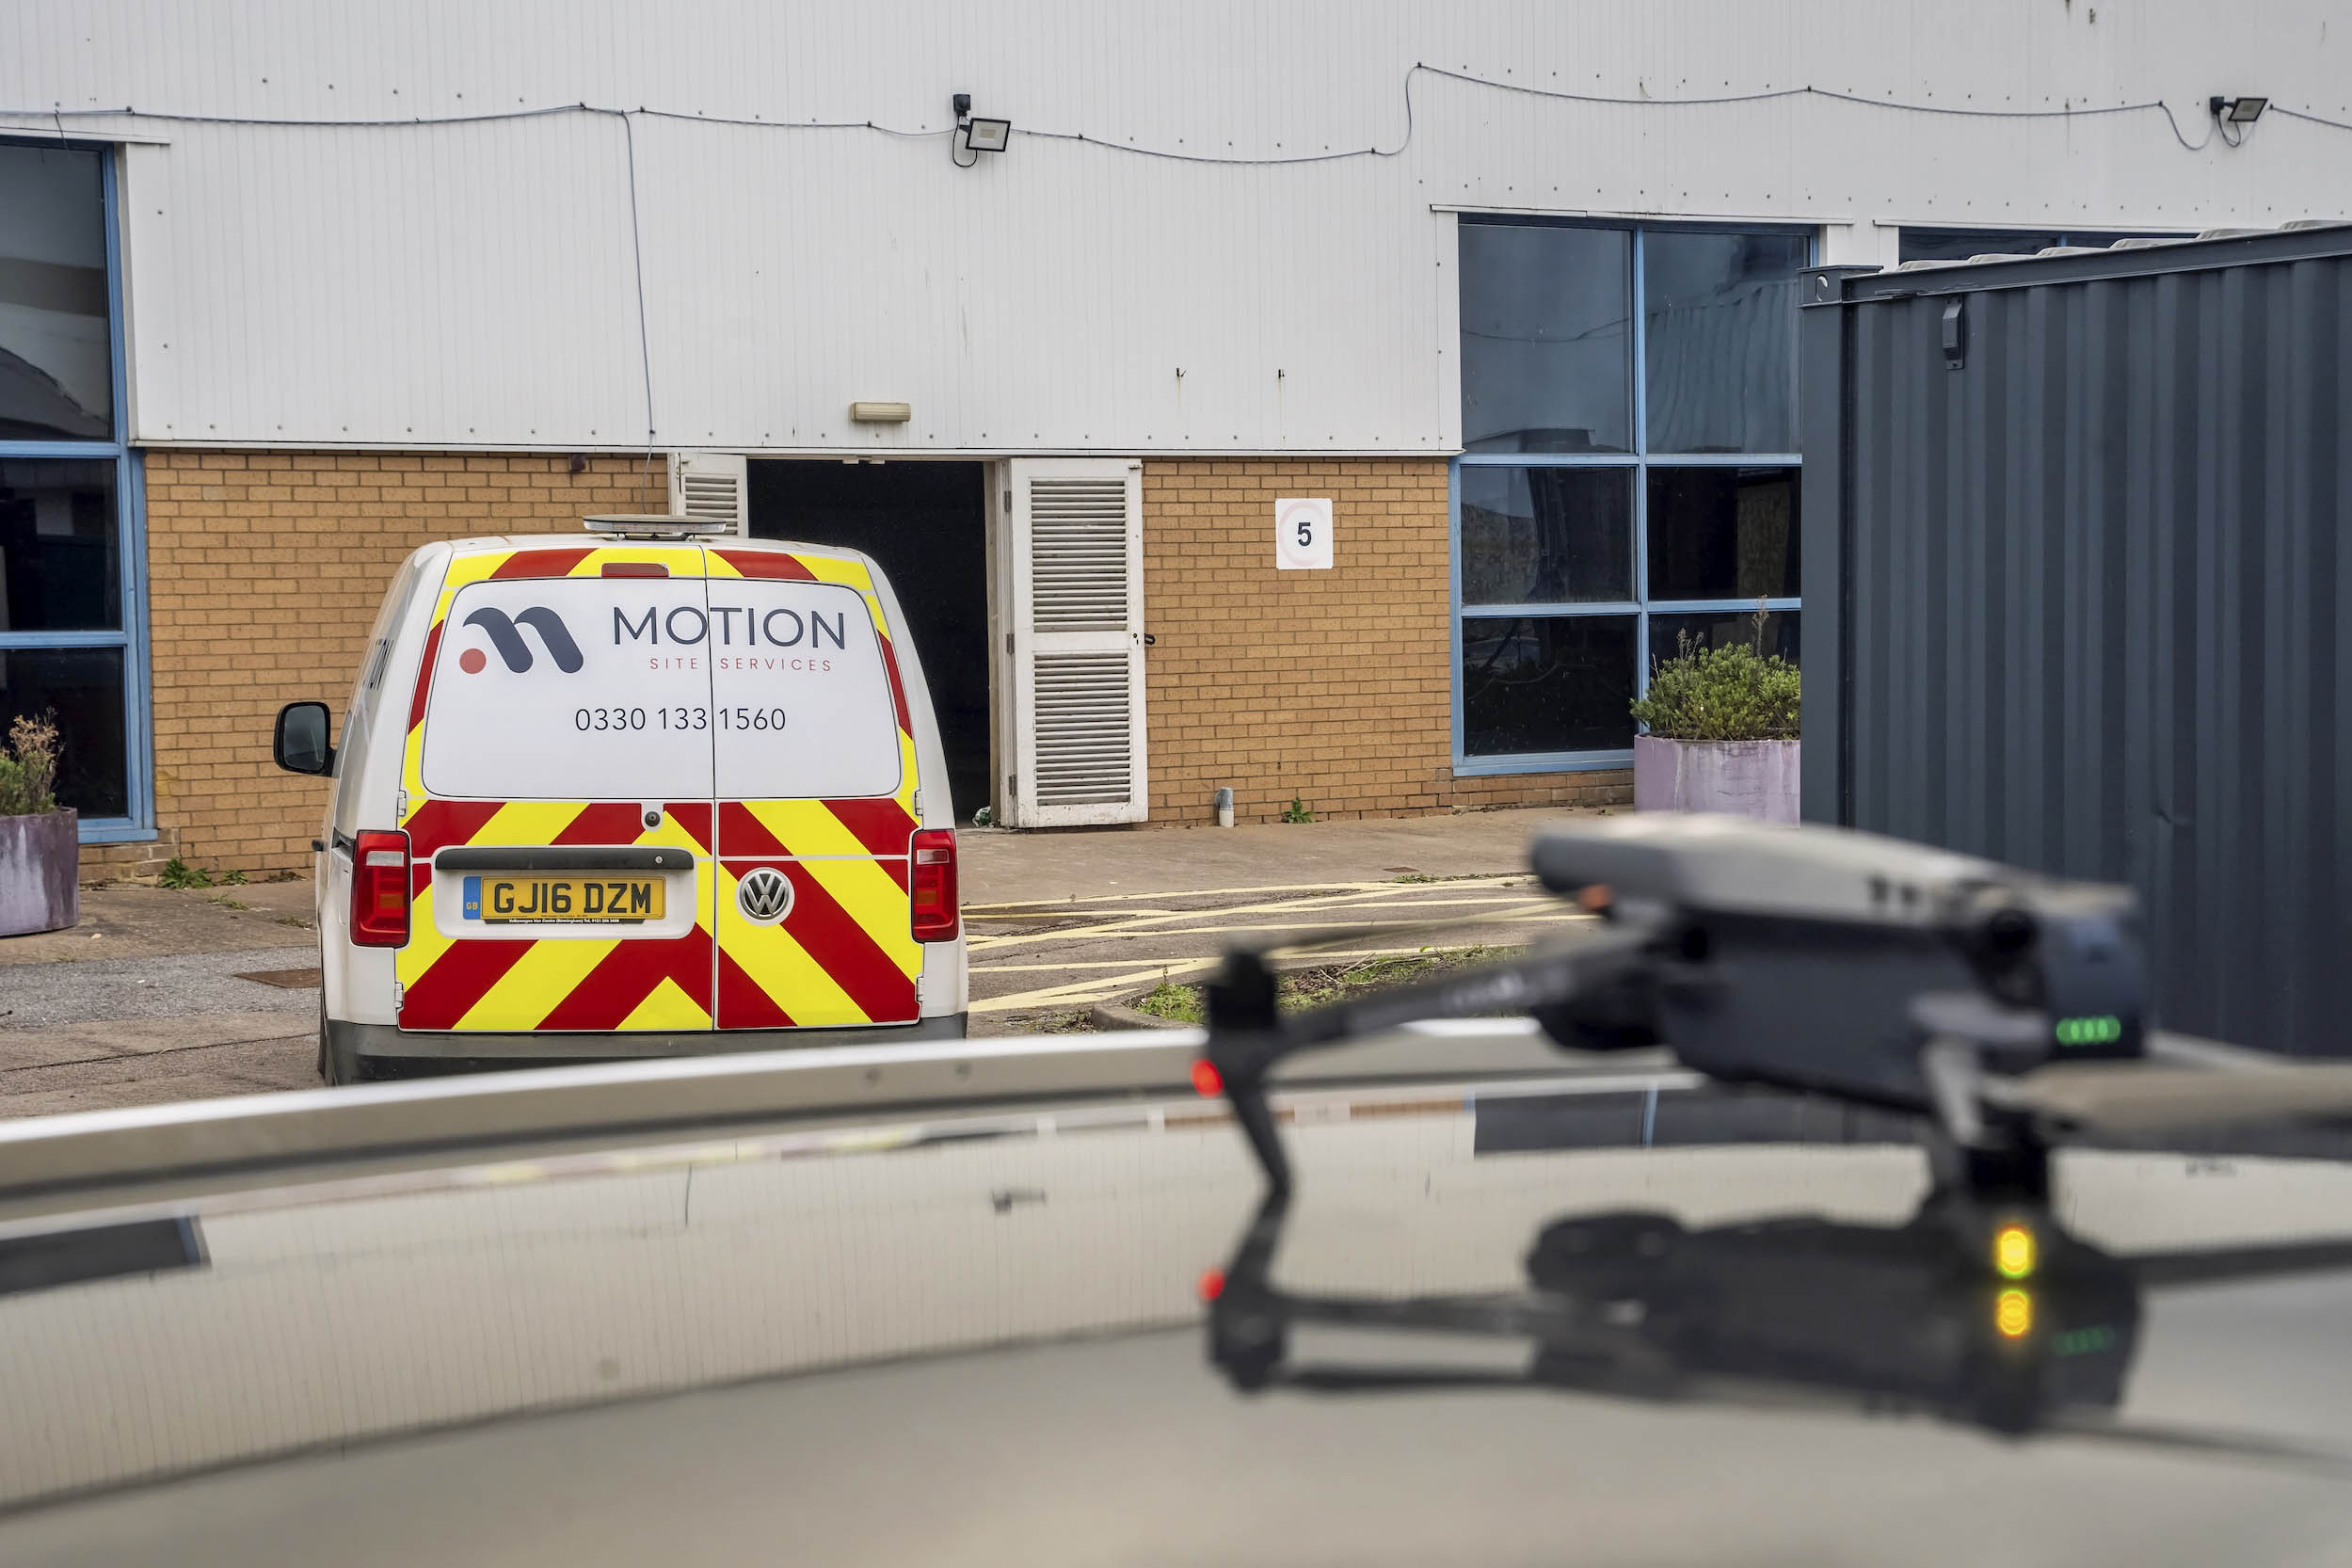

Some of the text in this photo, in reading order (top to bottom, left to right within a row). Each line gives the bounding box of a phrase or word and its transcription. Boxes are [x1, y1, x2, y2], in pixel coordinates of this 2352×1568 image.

[1297, 522, 1312, 546] 5
[614, 606, 845, 649] MOTION
[650, 658, 831, 671] SITE SERVICES
[575, 708, 786, 730] 0330 133 1560
[466, 902, 478, 911] GB
[494, 883, 651, 913] GJ16 DZM
